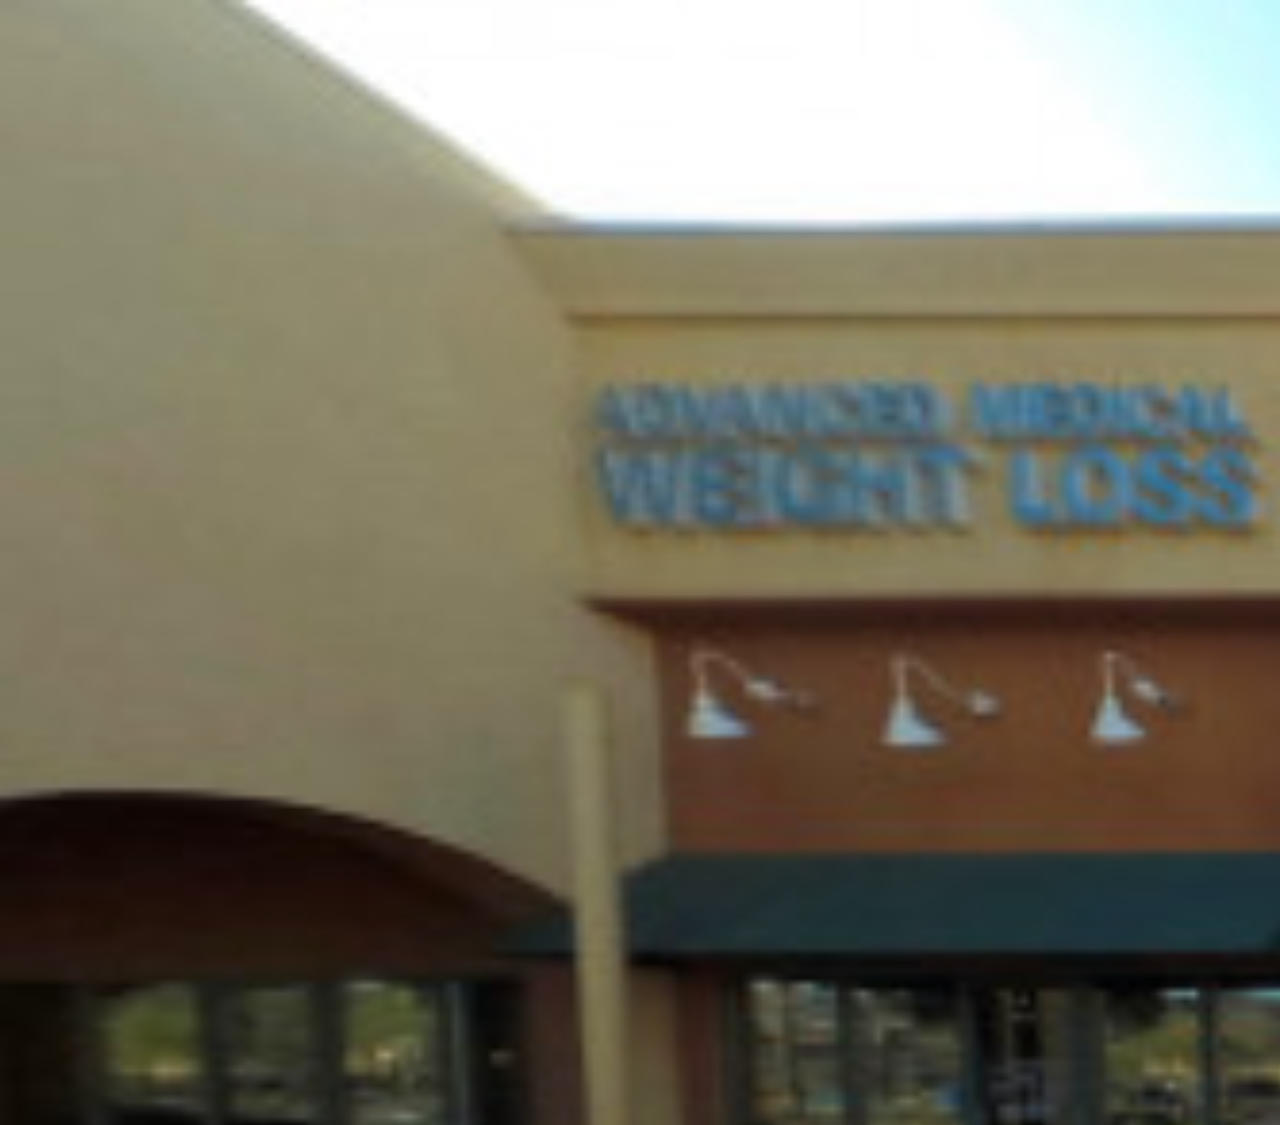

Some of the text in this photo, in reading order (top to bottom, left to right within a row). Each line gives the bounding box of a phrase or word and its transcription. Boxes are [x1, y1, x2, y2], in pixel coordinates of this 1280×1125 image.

[594, 382, 1254, 438] ADVANCED MEDICAL
[600, 444, 1261, 529] WEIGHT LOSS
